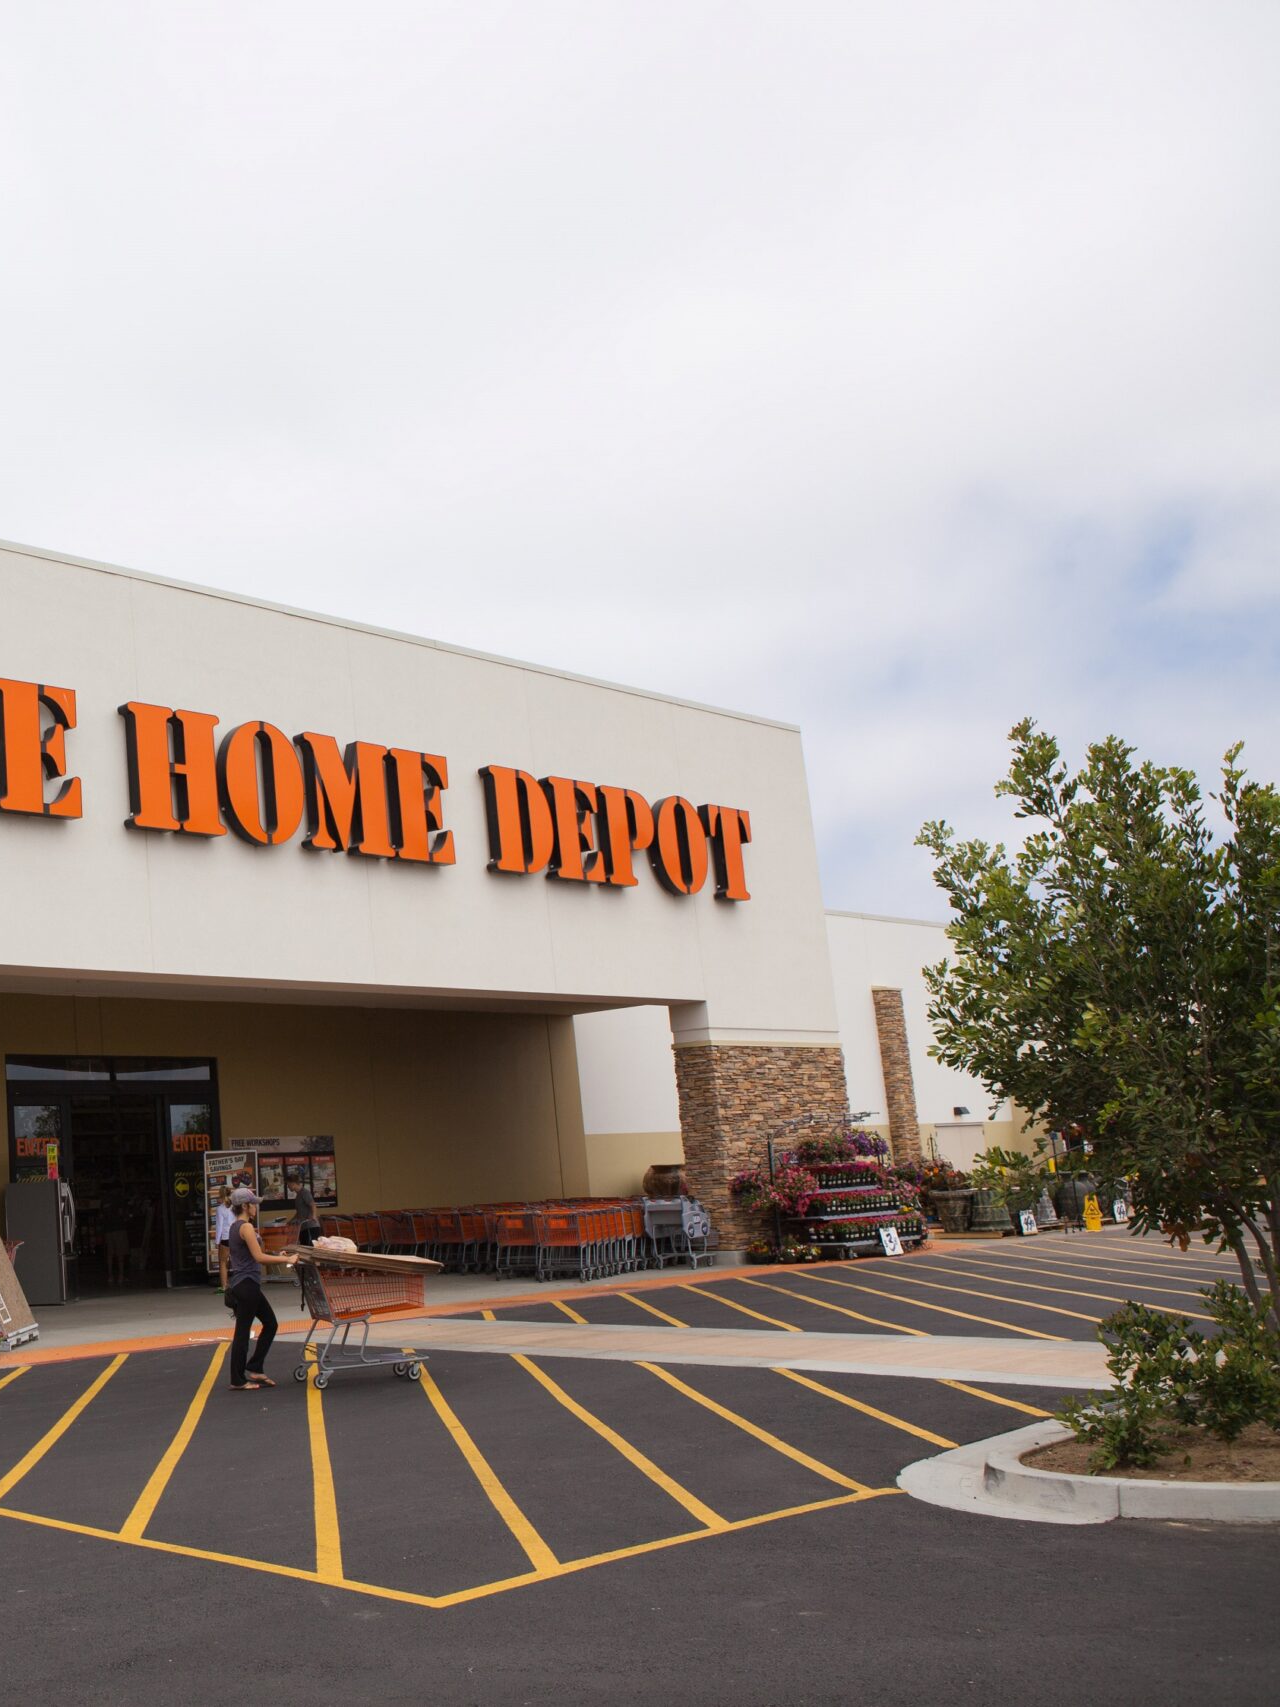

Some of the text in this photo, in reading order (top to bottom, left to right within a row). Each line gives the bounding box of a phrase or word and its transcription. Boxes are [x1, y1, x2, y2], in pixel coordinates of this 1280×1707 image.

[118, 701, 456, 867] HOME
[478, 764, 751, 902] DEPOT
[172, 1134, 210, 1152] ENTER
[231, 1138, 280, 1147] FREE WORKSHOPS
[208, 1158, 233, 1166] FATHER'S
[210, 1164, 232, 1172] SAVINGS
